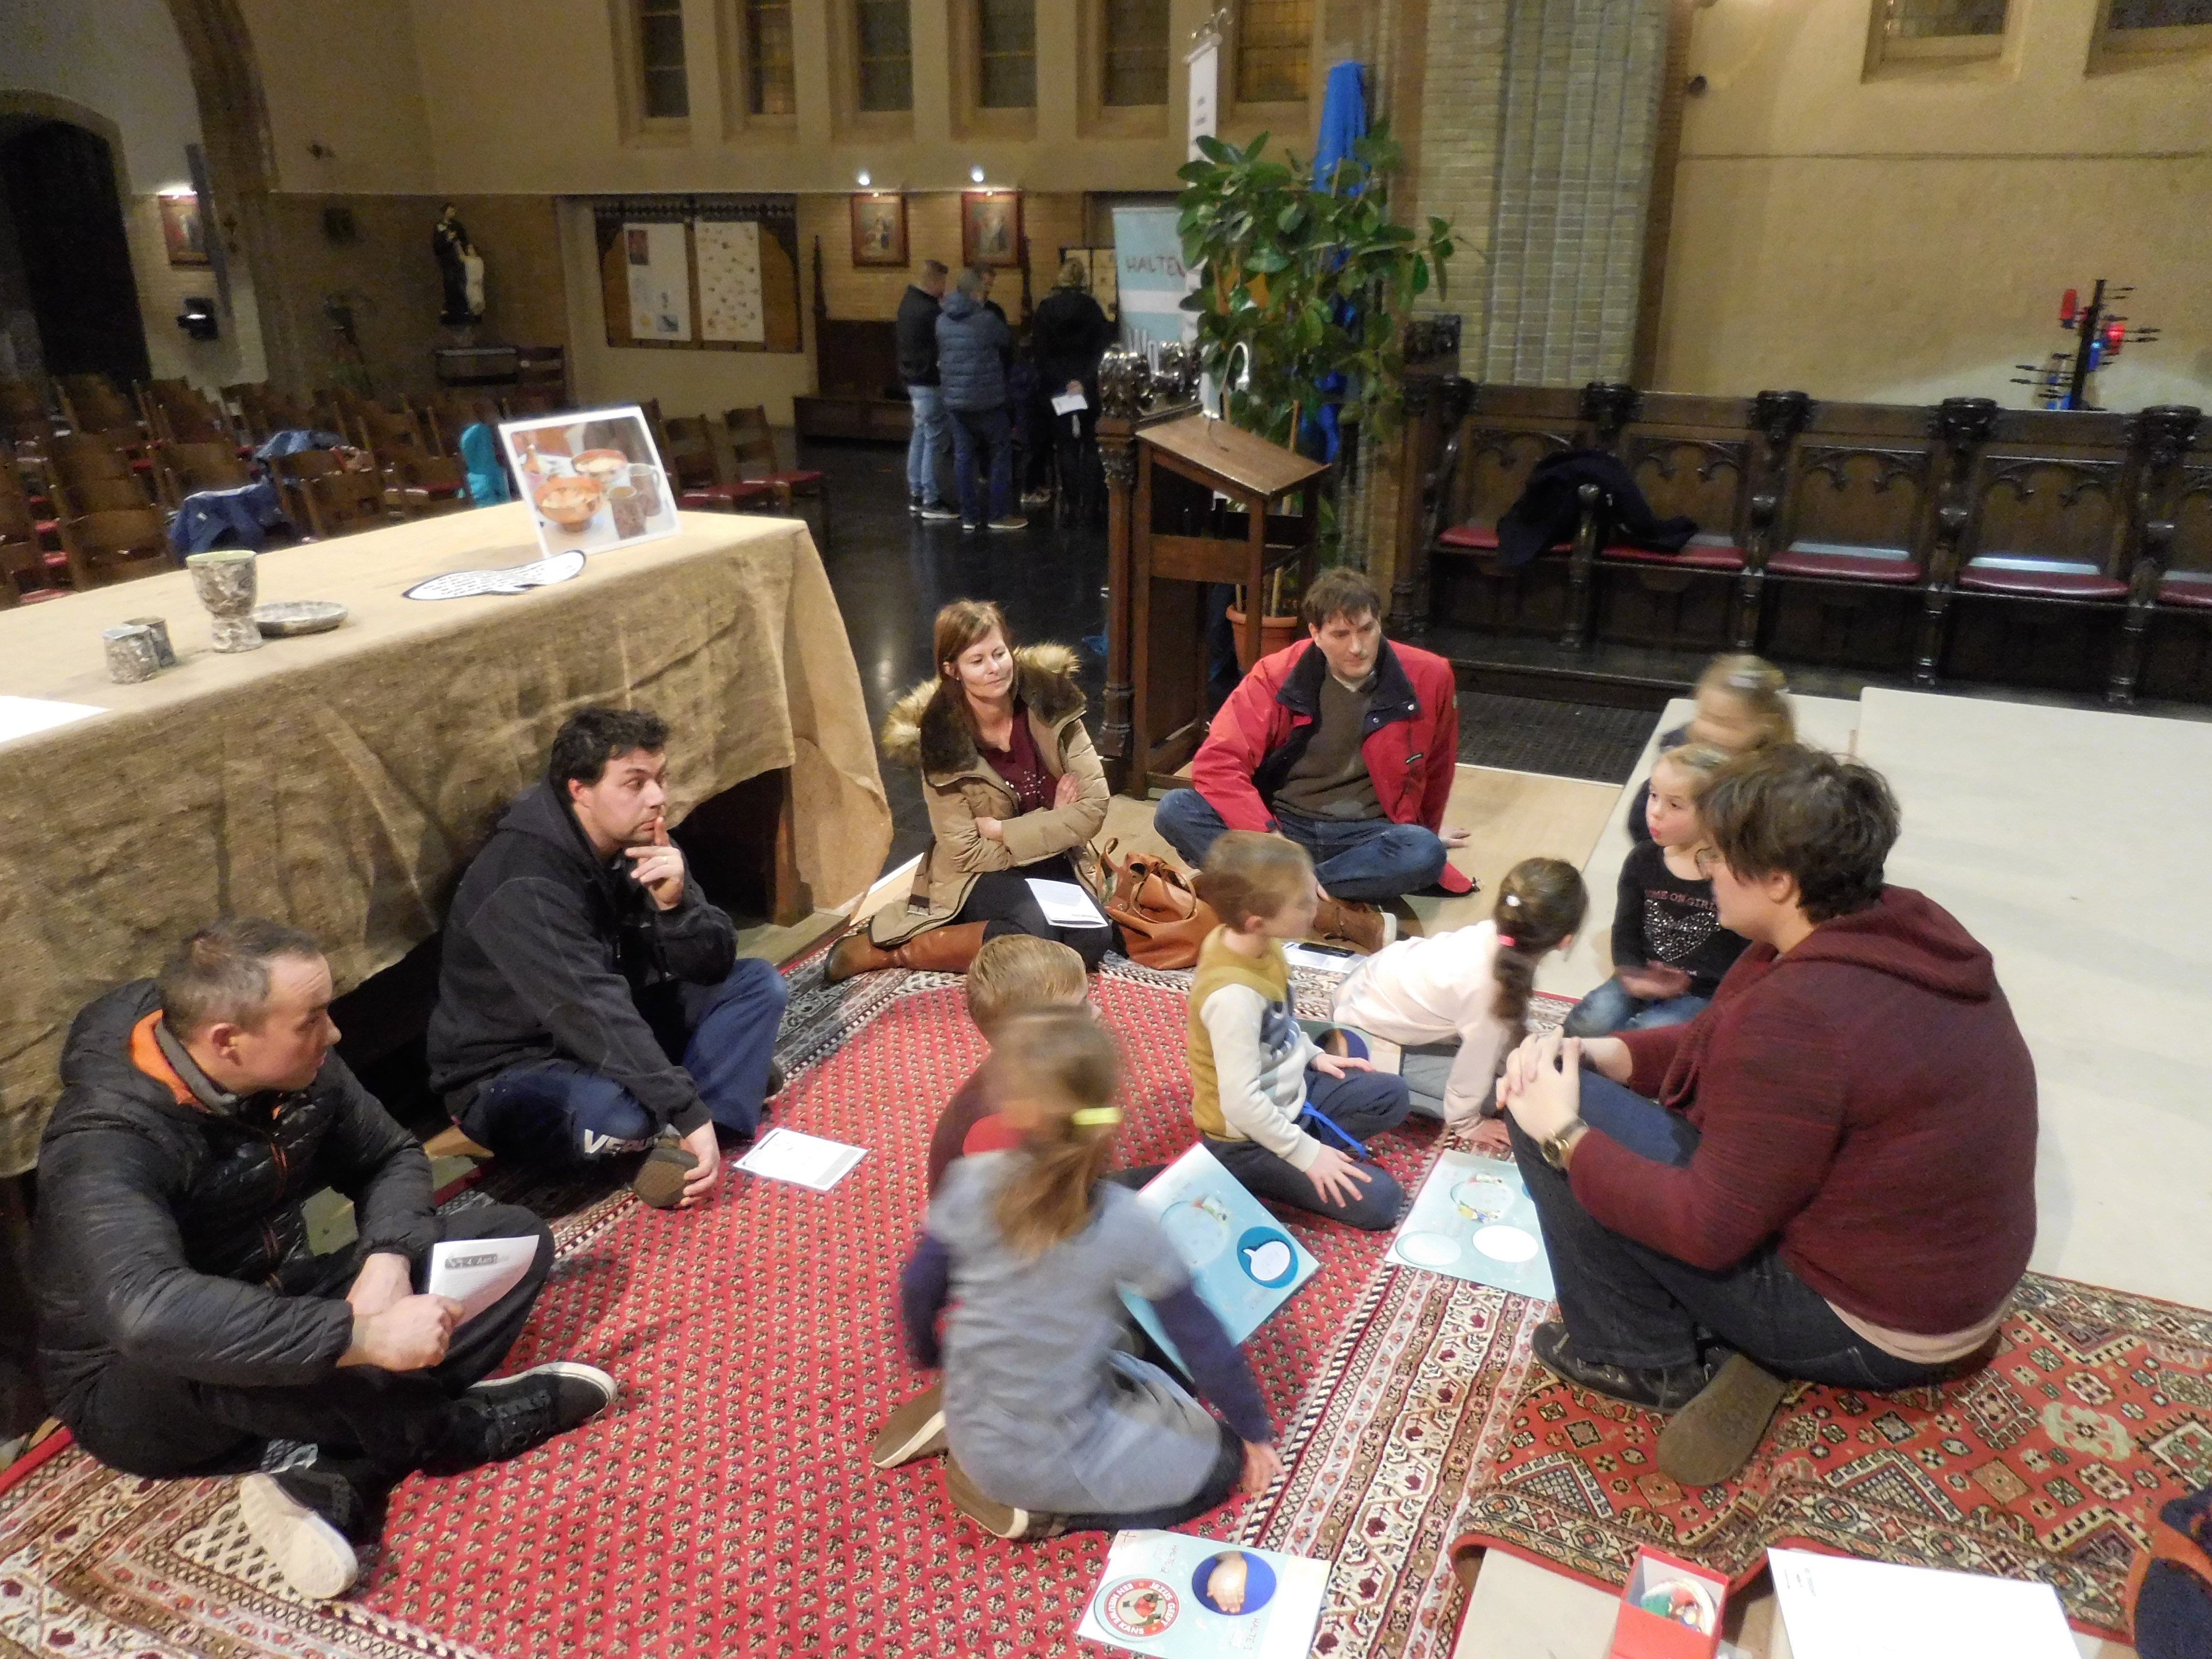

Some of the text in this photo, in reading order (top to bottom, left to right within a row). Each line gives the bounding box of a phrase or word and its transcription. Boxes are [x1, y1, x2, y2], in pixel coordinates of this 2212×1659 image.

[1108, 1583, 1144, 1635] EEN NIEUWE KANS
[1149, 1582, 1176, 1626] JEZUS GEEFT
